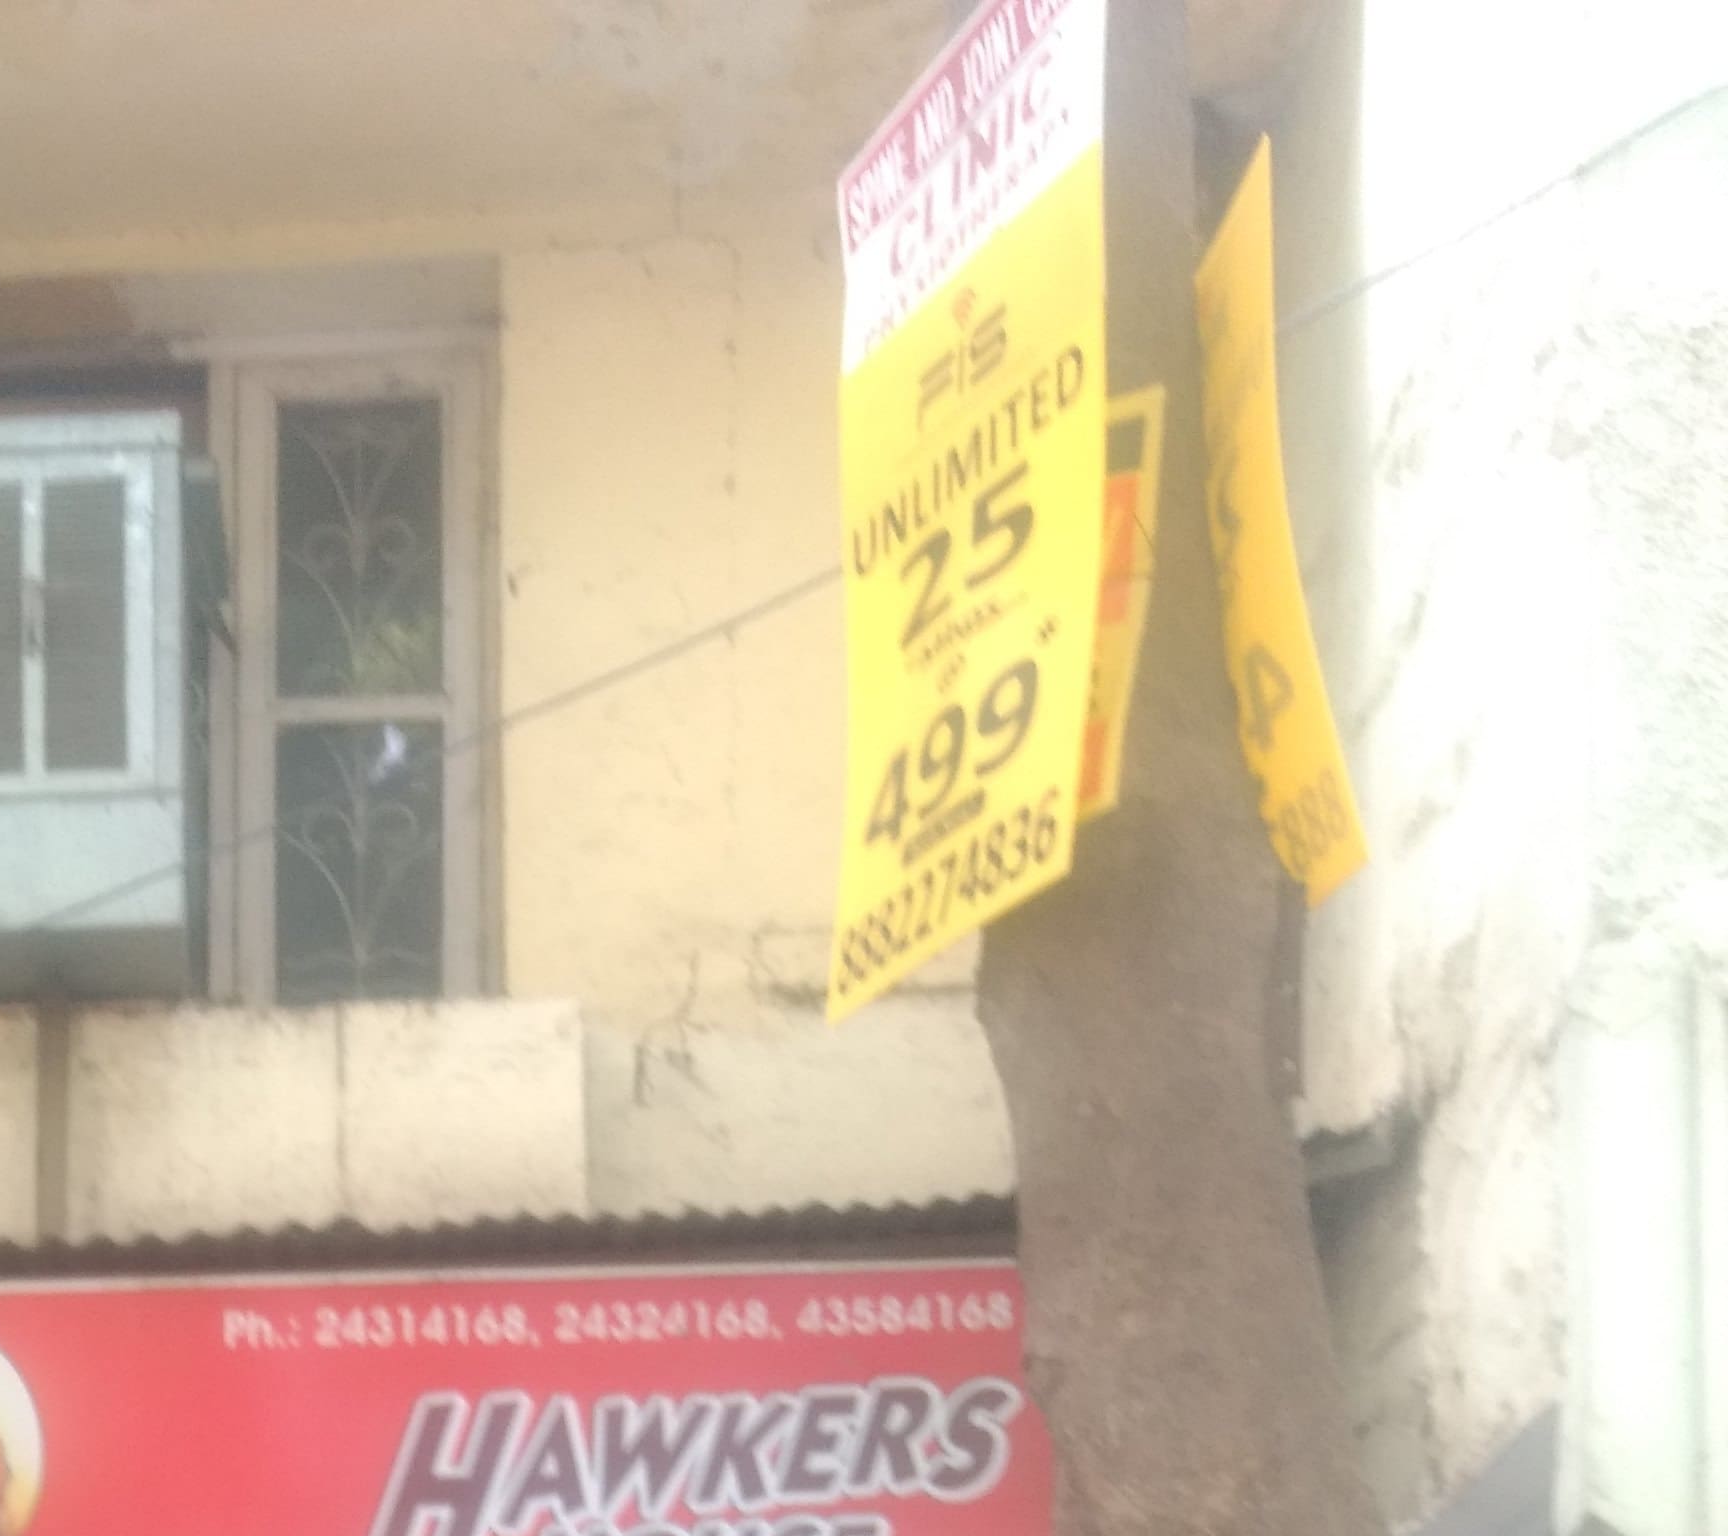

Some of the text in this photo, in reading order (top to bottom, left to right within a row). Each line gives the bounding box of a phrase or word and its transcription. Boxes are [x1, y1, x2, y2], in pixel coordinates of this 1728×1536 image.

[888, 50, 1052, 276] CLINIC
[914, 74, 961, 168] AND
[853, 344, 1083, 577] UNLIMITED
[899, 457, 1035, 650] 25
[864, 656, 1039, 850] 499
[311, 1303, 542, 1350] 24314168,
[553, 1298, 784, 1344] 24324168,
[796, 1290, 1015, 1336] 43584168
